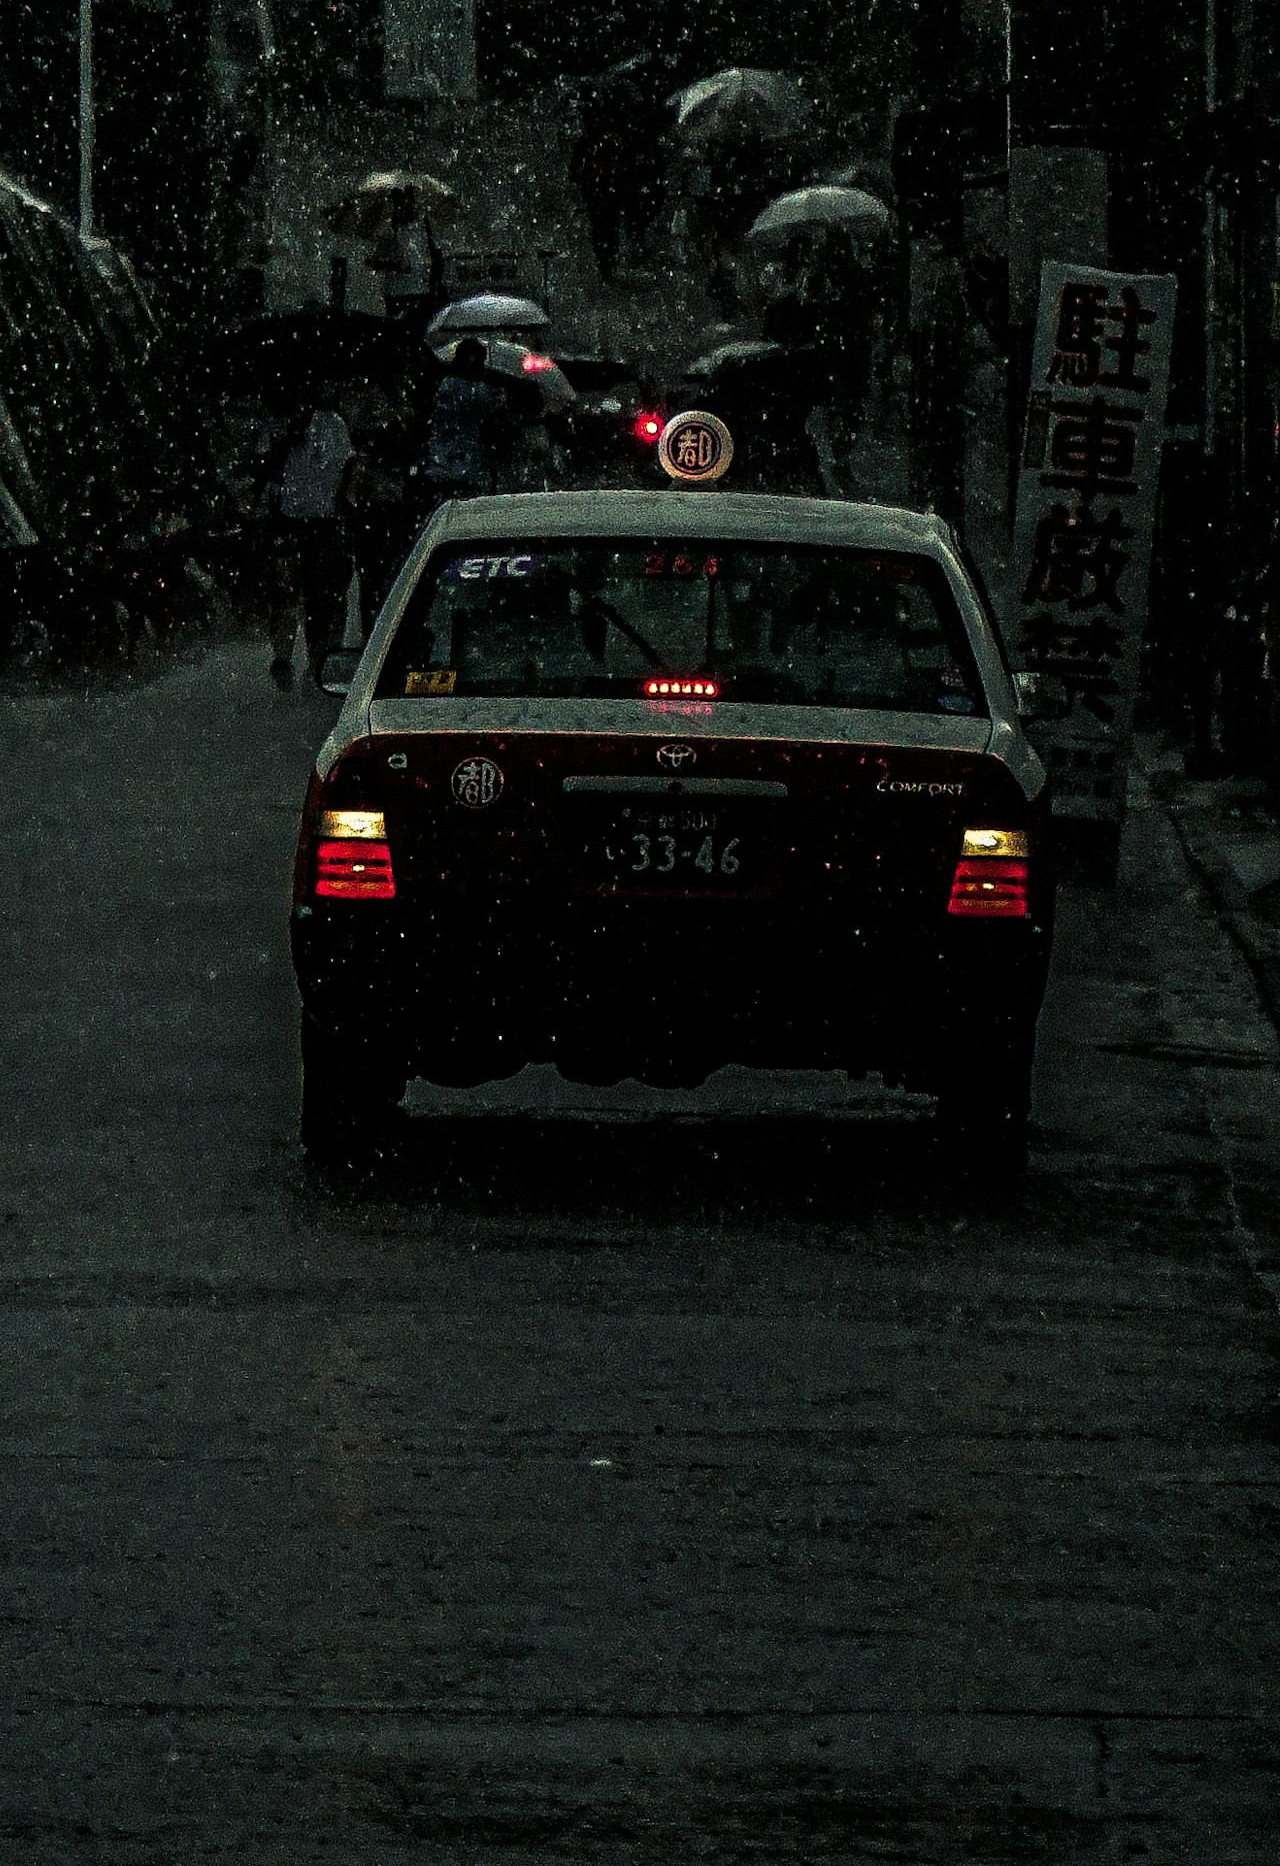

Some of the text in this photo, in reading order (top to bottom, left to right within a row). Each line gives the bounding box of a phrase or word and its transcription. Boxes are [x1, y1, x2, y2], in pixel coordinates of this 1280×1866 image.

[1020, 281, 1158, 723] 駐車厳禁
[459, 555, 535, 579] ETC
[876, 780, 965, 797] COMFORT
[630, 832, 742, 875] 33-46
